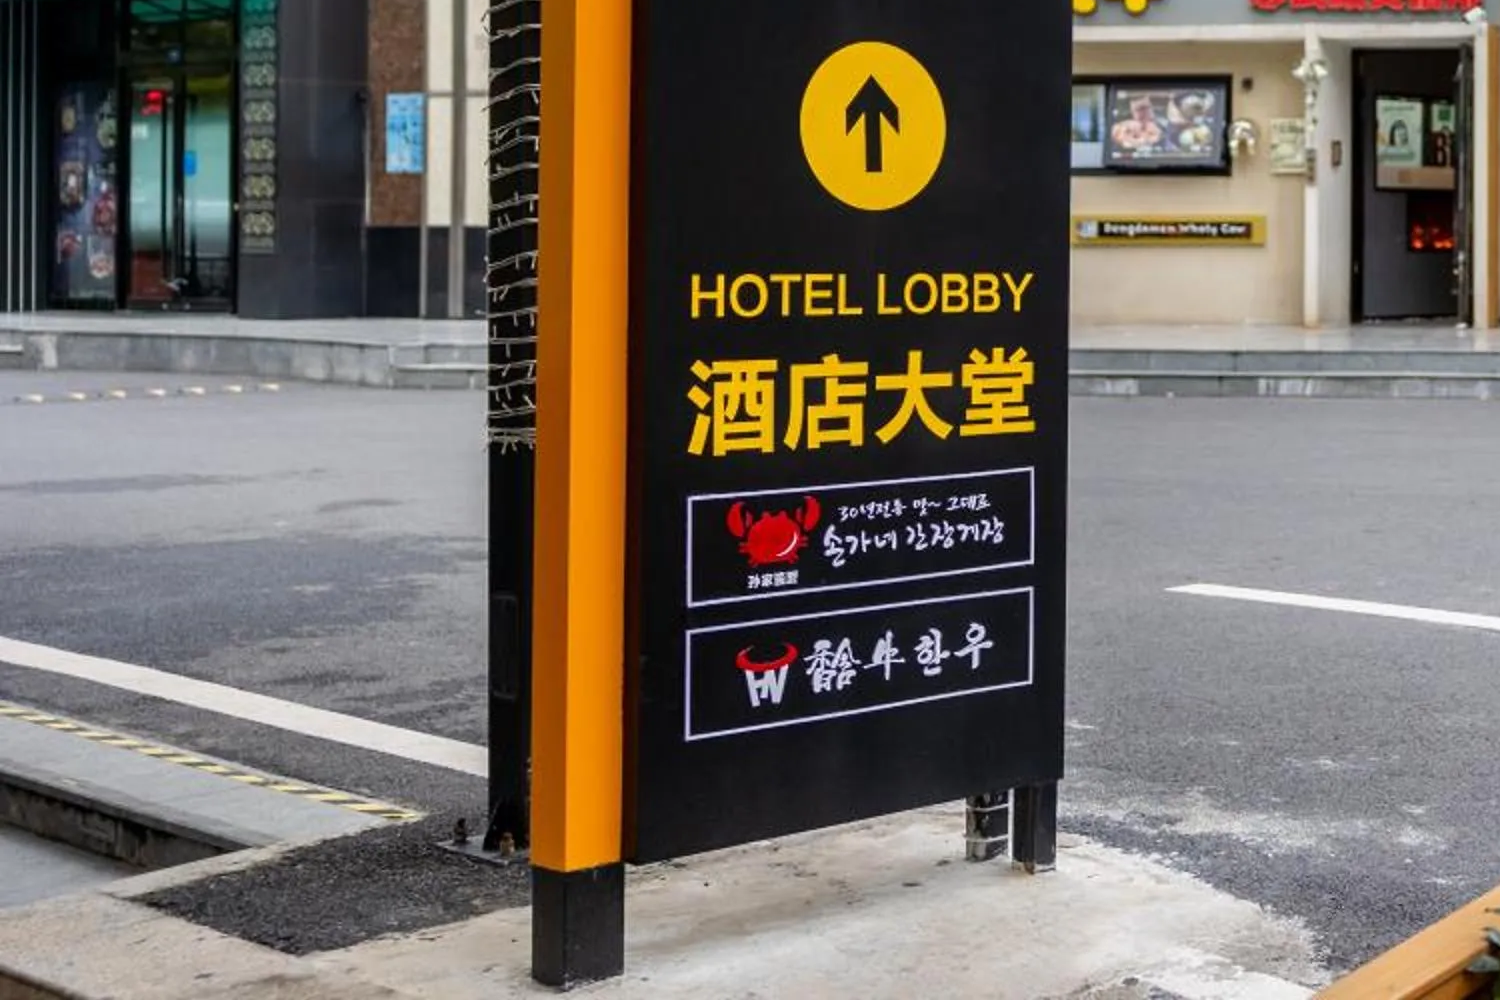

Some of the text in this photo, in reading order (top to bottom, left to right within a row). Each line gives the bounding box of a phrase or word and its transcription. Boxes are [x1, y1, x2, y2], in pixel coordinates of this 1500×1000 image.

[690, 272, 1034, 319] HOTEL LOBBY
[686, 346, 1036, 458] 酒店大堂
[823, 515, 1006, 568] 손가네 간장게장
[913, 622, 995, 675] 한우
